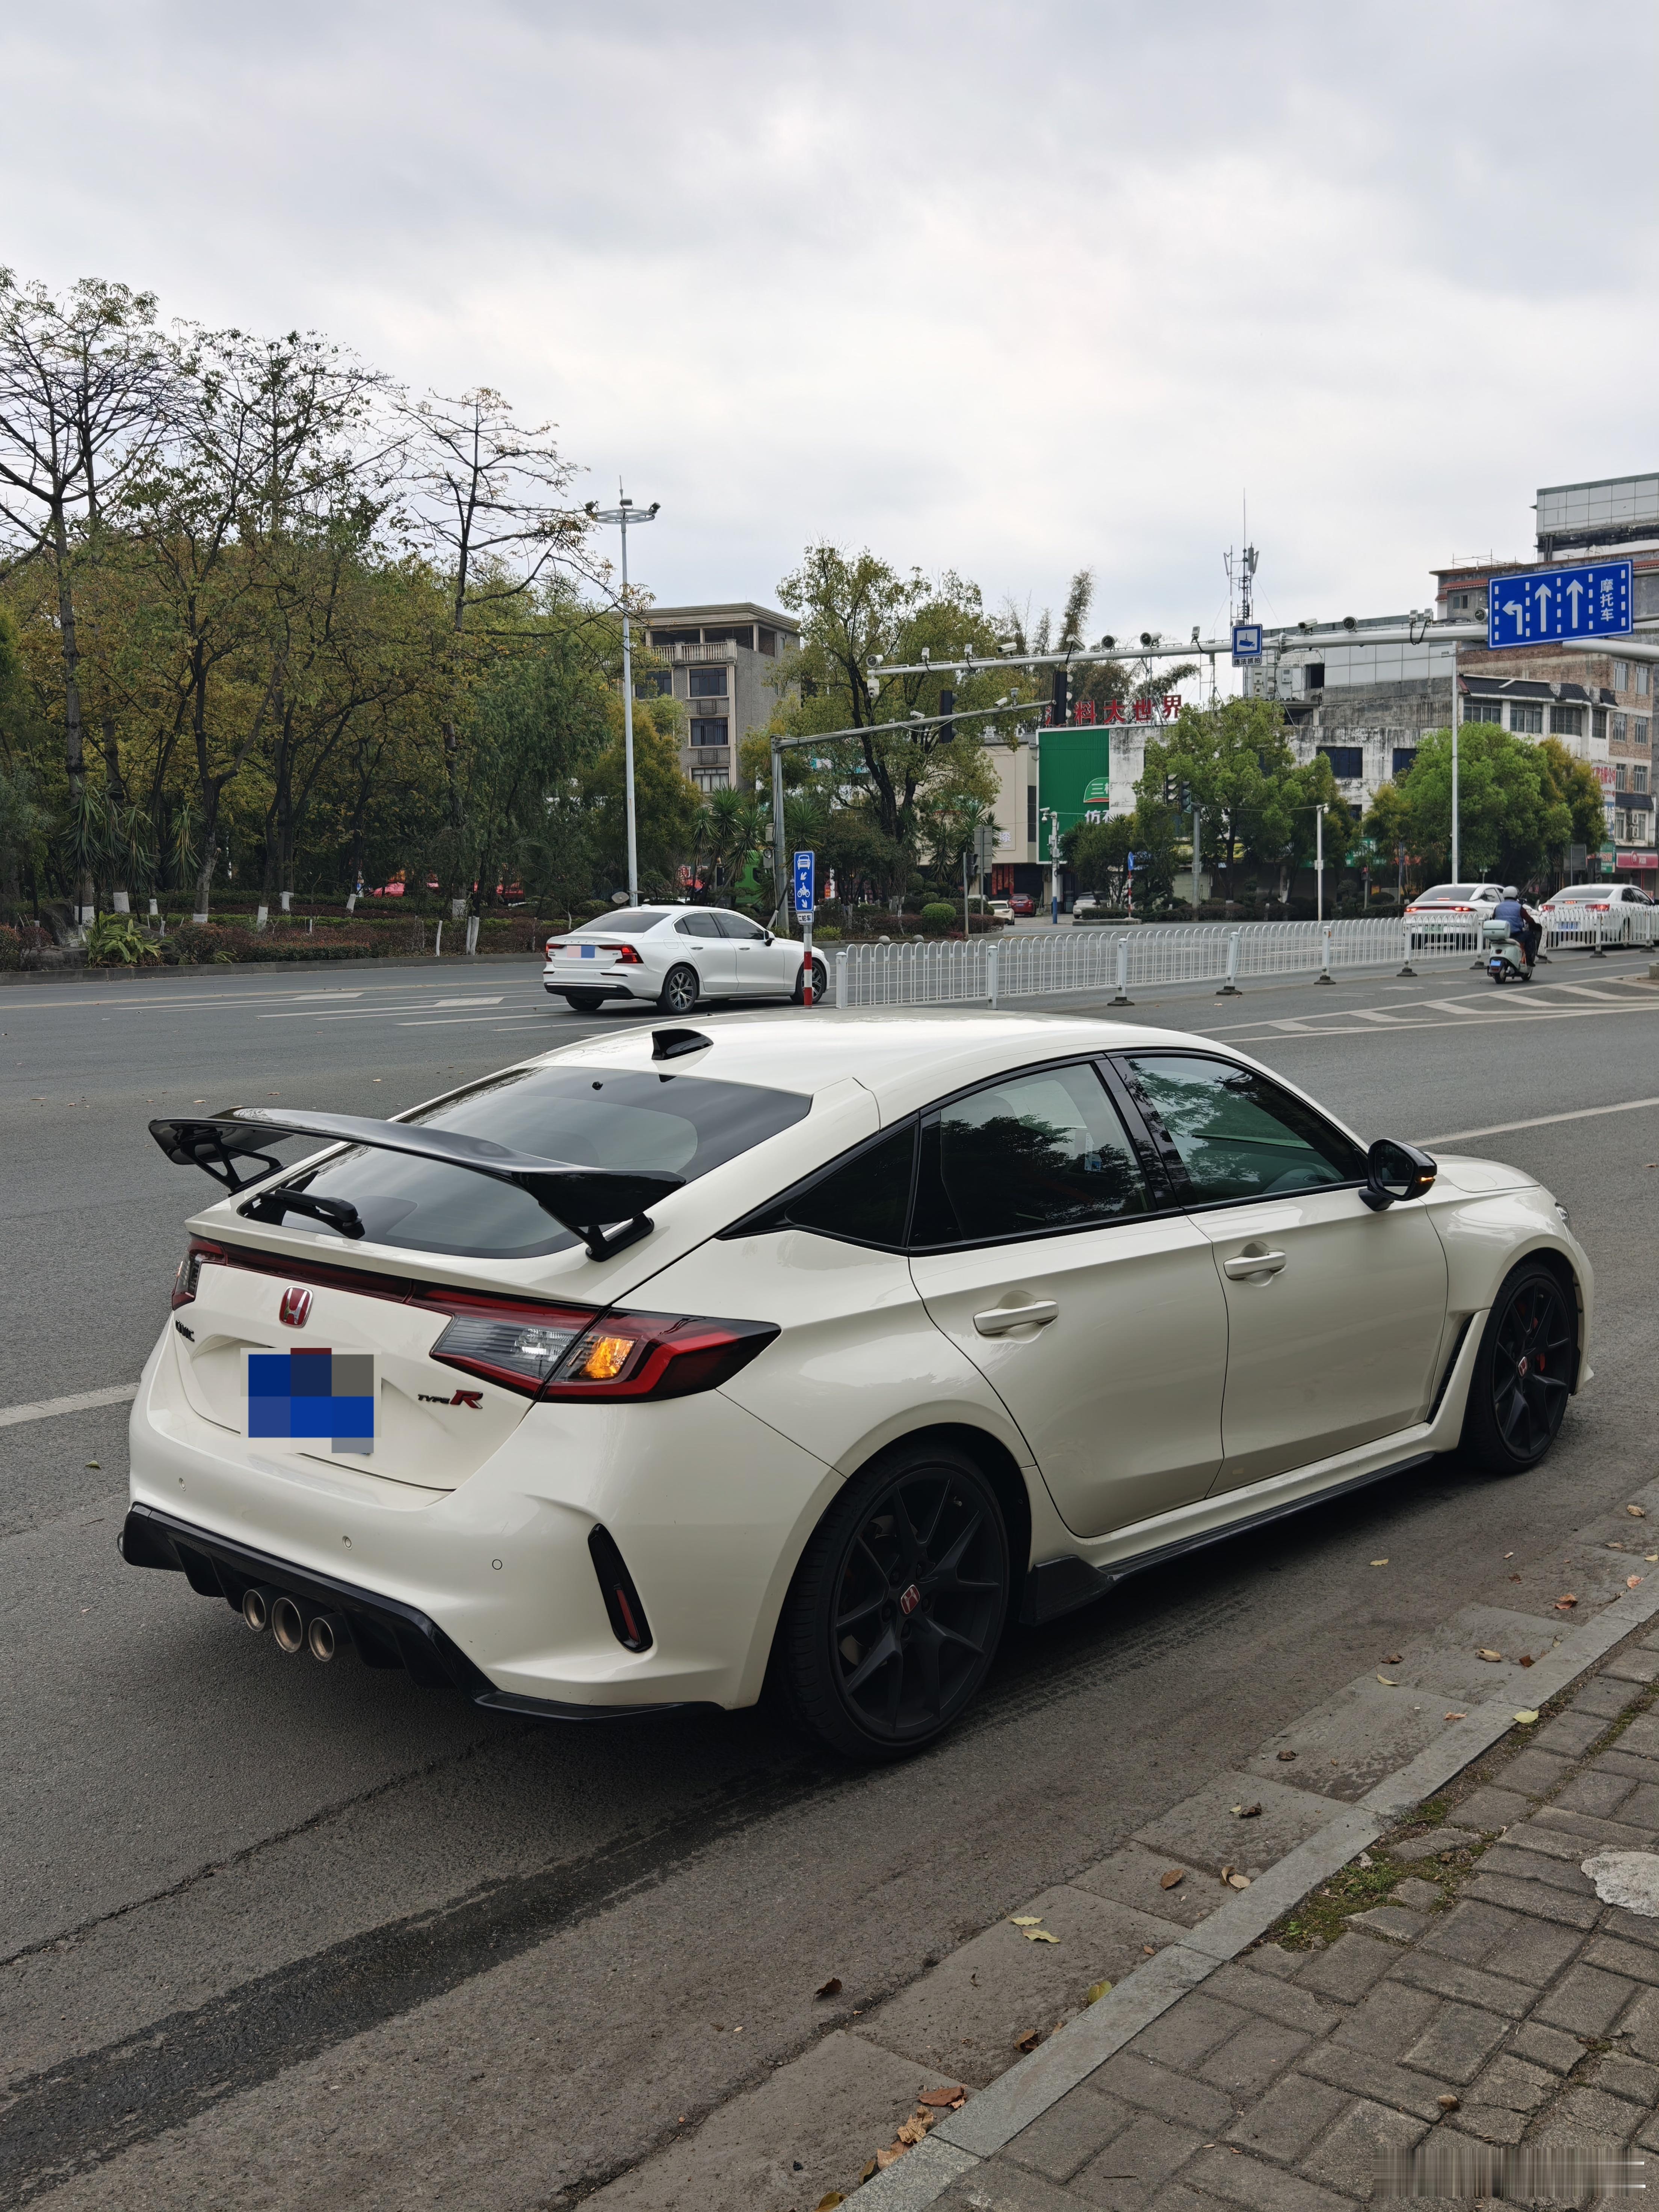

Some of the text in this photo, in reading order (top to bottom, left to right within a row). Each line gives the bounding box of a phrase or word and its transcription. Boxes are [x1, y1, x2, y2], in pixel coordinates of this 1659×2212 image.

[1600, 578, 1614, 622] 摩托车
[1045, 695, 1181, 726] 料大世界
[418, 1390, 483, 1409] TYPE R
